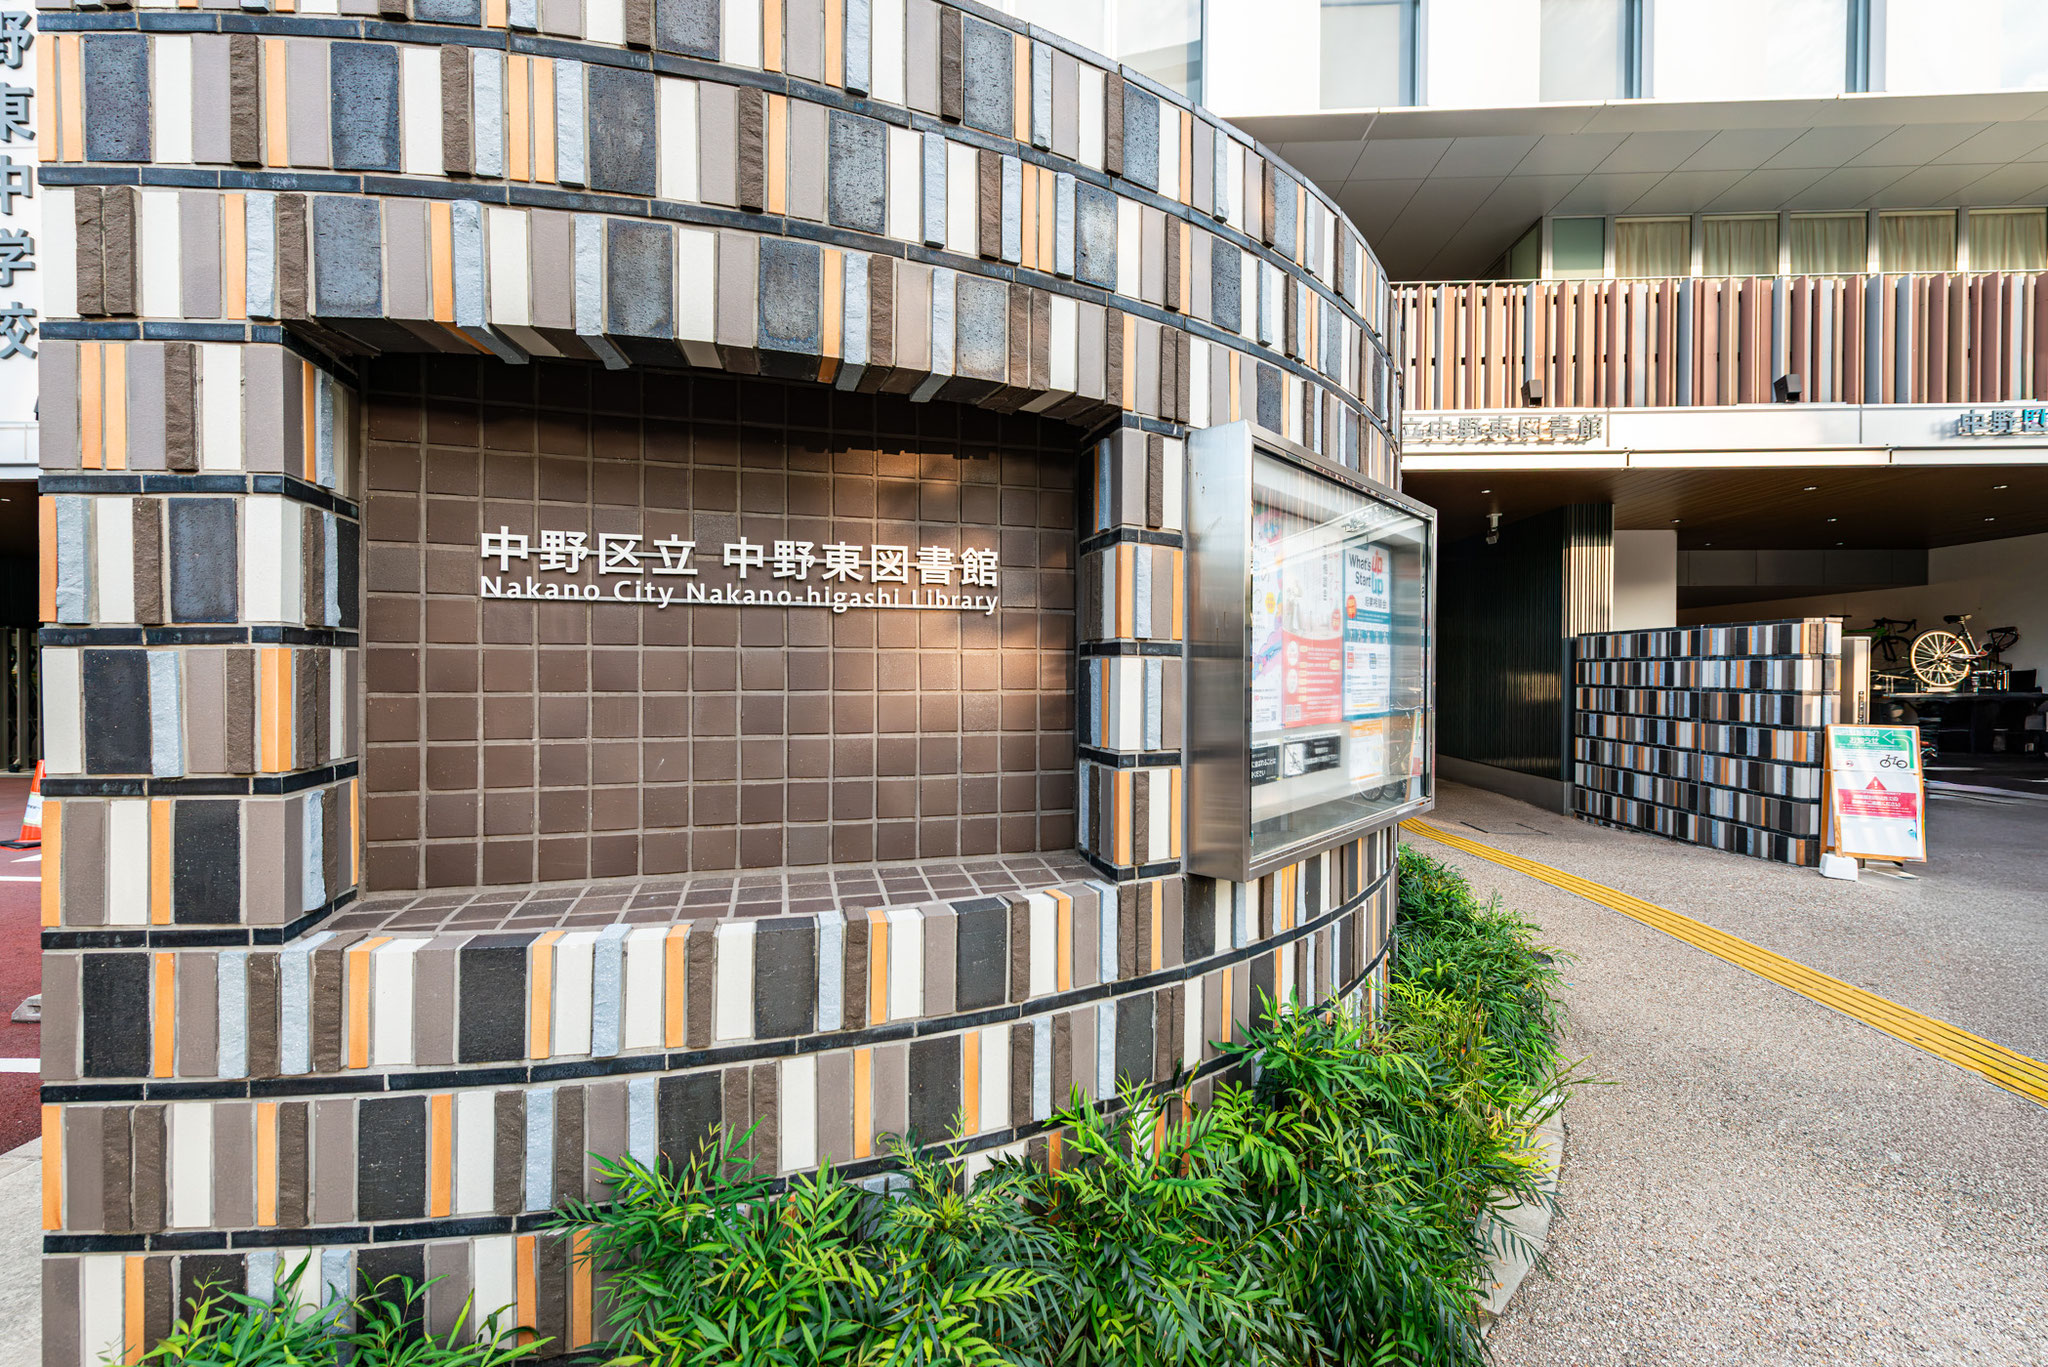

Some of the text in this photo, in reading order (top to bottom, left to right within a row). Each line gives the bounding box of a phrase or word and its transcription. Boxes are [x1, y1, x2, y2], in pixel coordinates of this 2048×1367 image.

[481, 526, 998, 588] 中野区立 中野東図書館
[480, 576, 998, 616] Nakano City Nakano-higashi Library
[1355, 571, 1371, 588] Start
